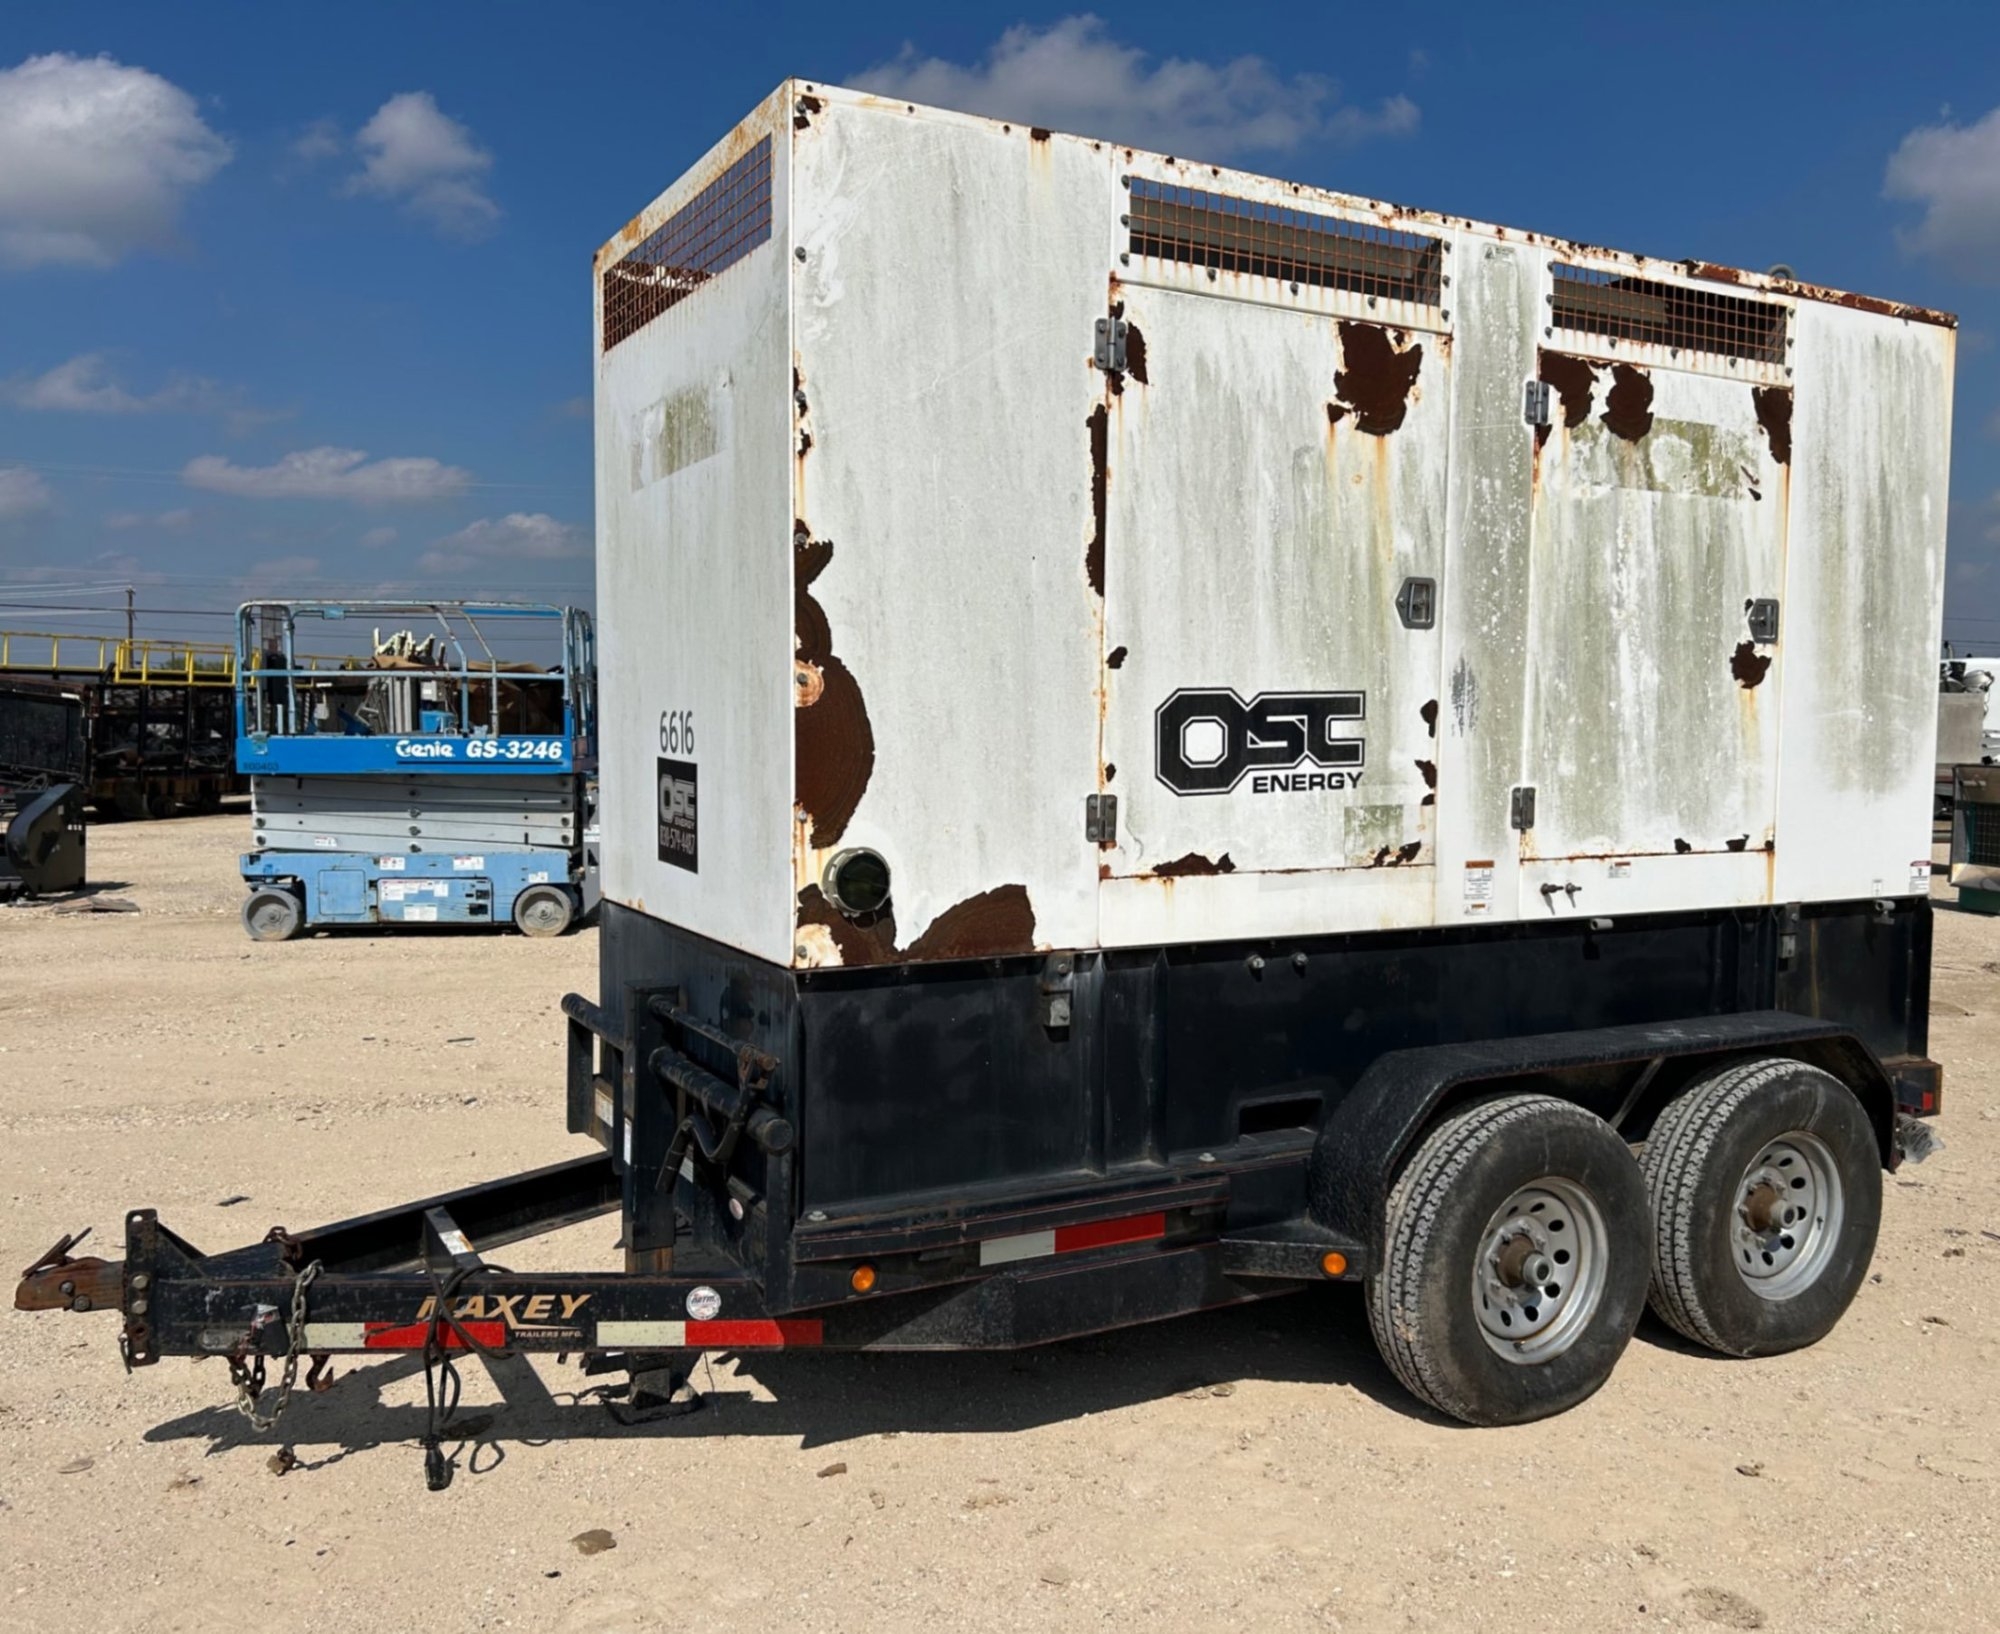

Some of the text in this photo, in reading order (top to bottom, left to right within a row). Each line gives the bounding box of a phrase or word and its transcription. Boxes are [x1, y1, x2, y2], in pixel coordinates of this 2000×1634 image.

[660, 710, 695, 755] 6616
[1155, 687, 1366, 797] OSC
[395, 740, 563, 759] Genie GS-3246
[1252, 772, 1363, 794] ENERGY
[514, 1331, 559, 1339] TRAILERS
